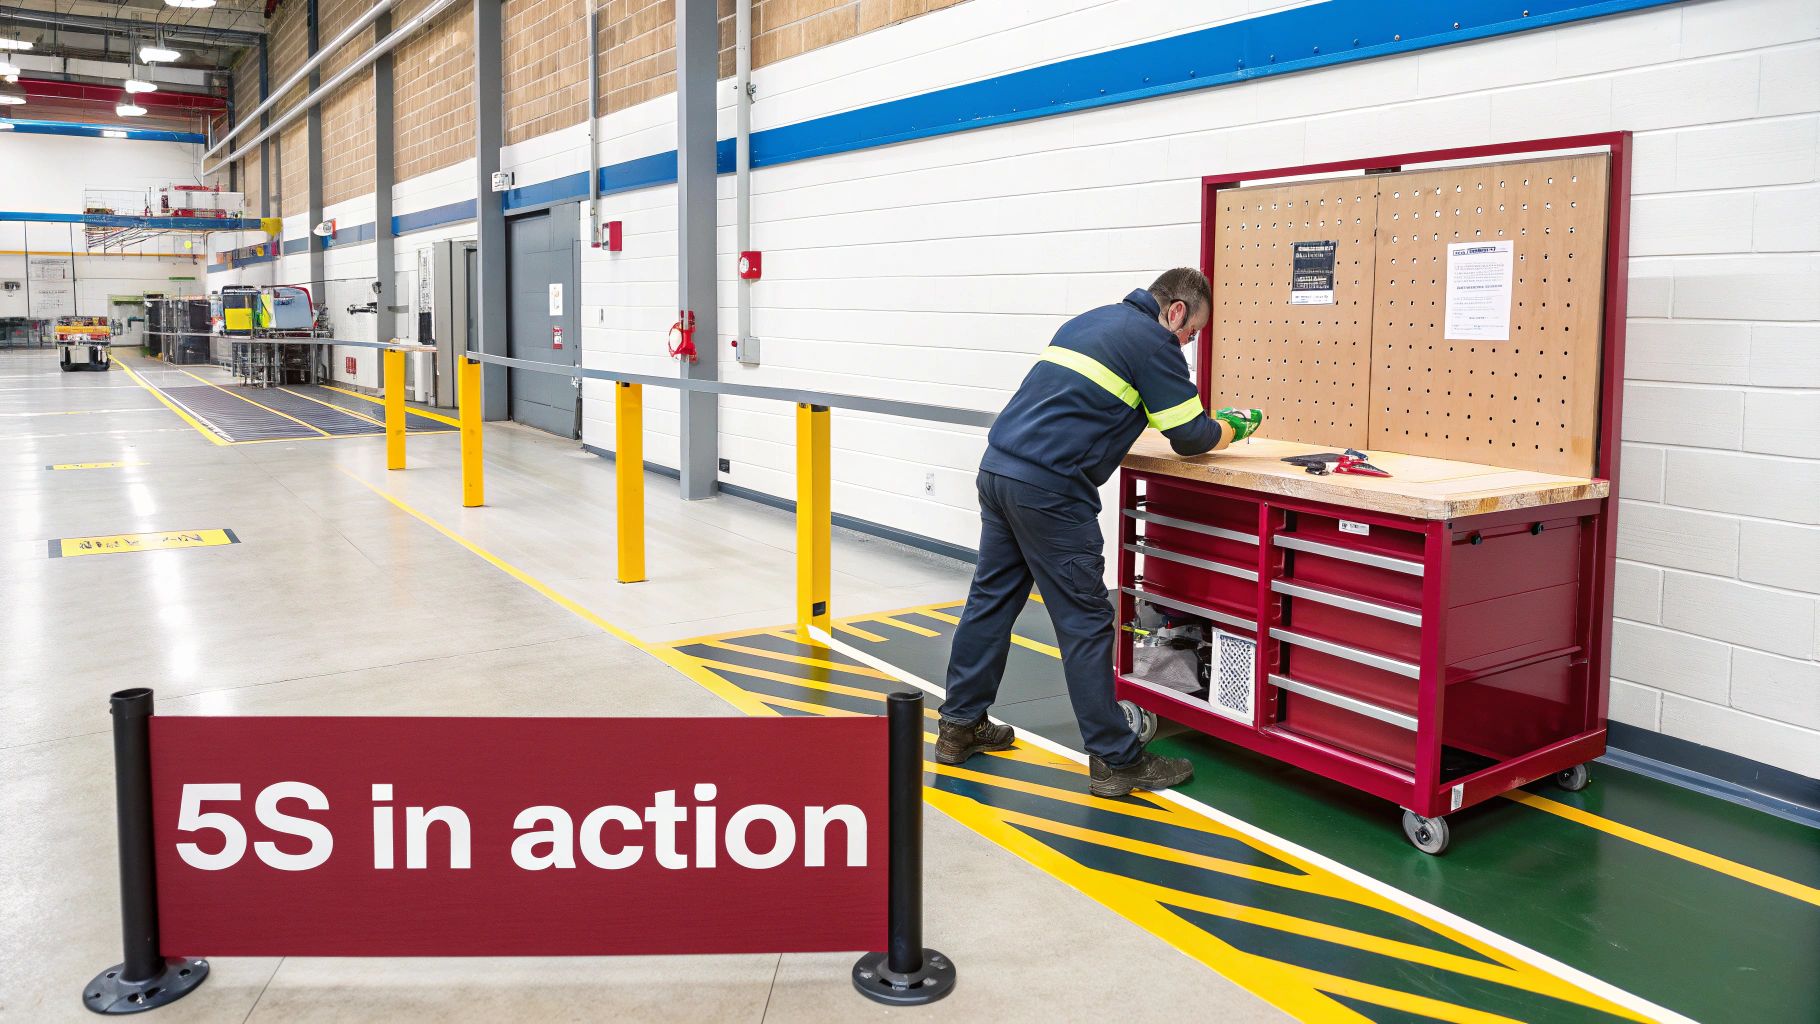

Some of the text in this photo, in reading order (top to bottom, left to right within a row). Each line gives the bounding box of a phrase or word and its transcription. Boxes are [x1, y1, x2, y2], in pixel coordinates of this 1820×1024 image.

[175, 781, 868, 872] 5S in action
